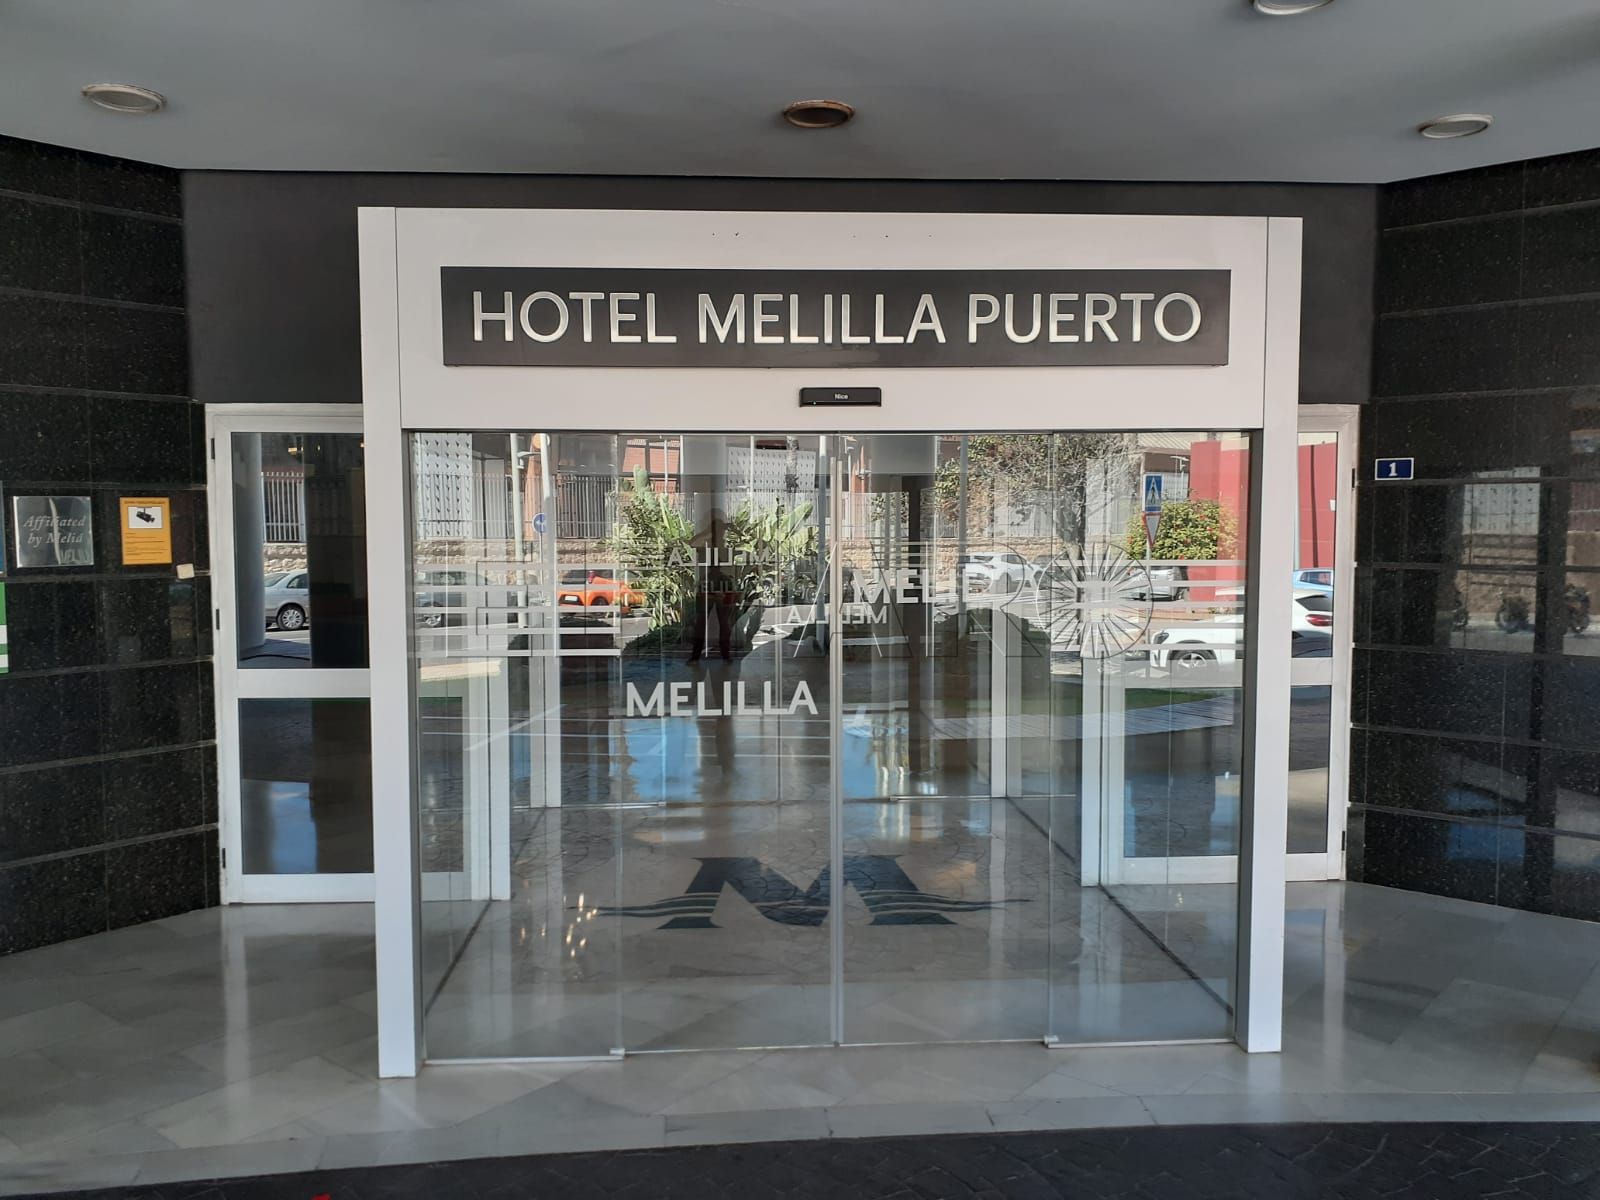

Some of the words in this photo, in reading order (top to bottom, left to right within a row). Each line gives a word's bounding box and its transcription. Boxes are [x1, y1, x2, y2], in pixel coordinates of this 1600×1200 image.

[472, 290, 678, 344] HOTEL
[697, 292, 947, 344] MELILLA
[967, 291, 1202, 344] PUERTO
[1389, 462, 1398, 477] 1
[27, 532, 42, 548] by
[626, 680, 819, 717] MELILLA
